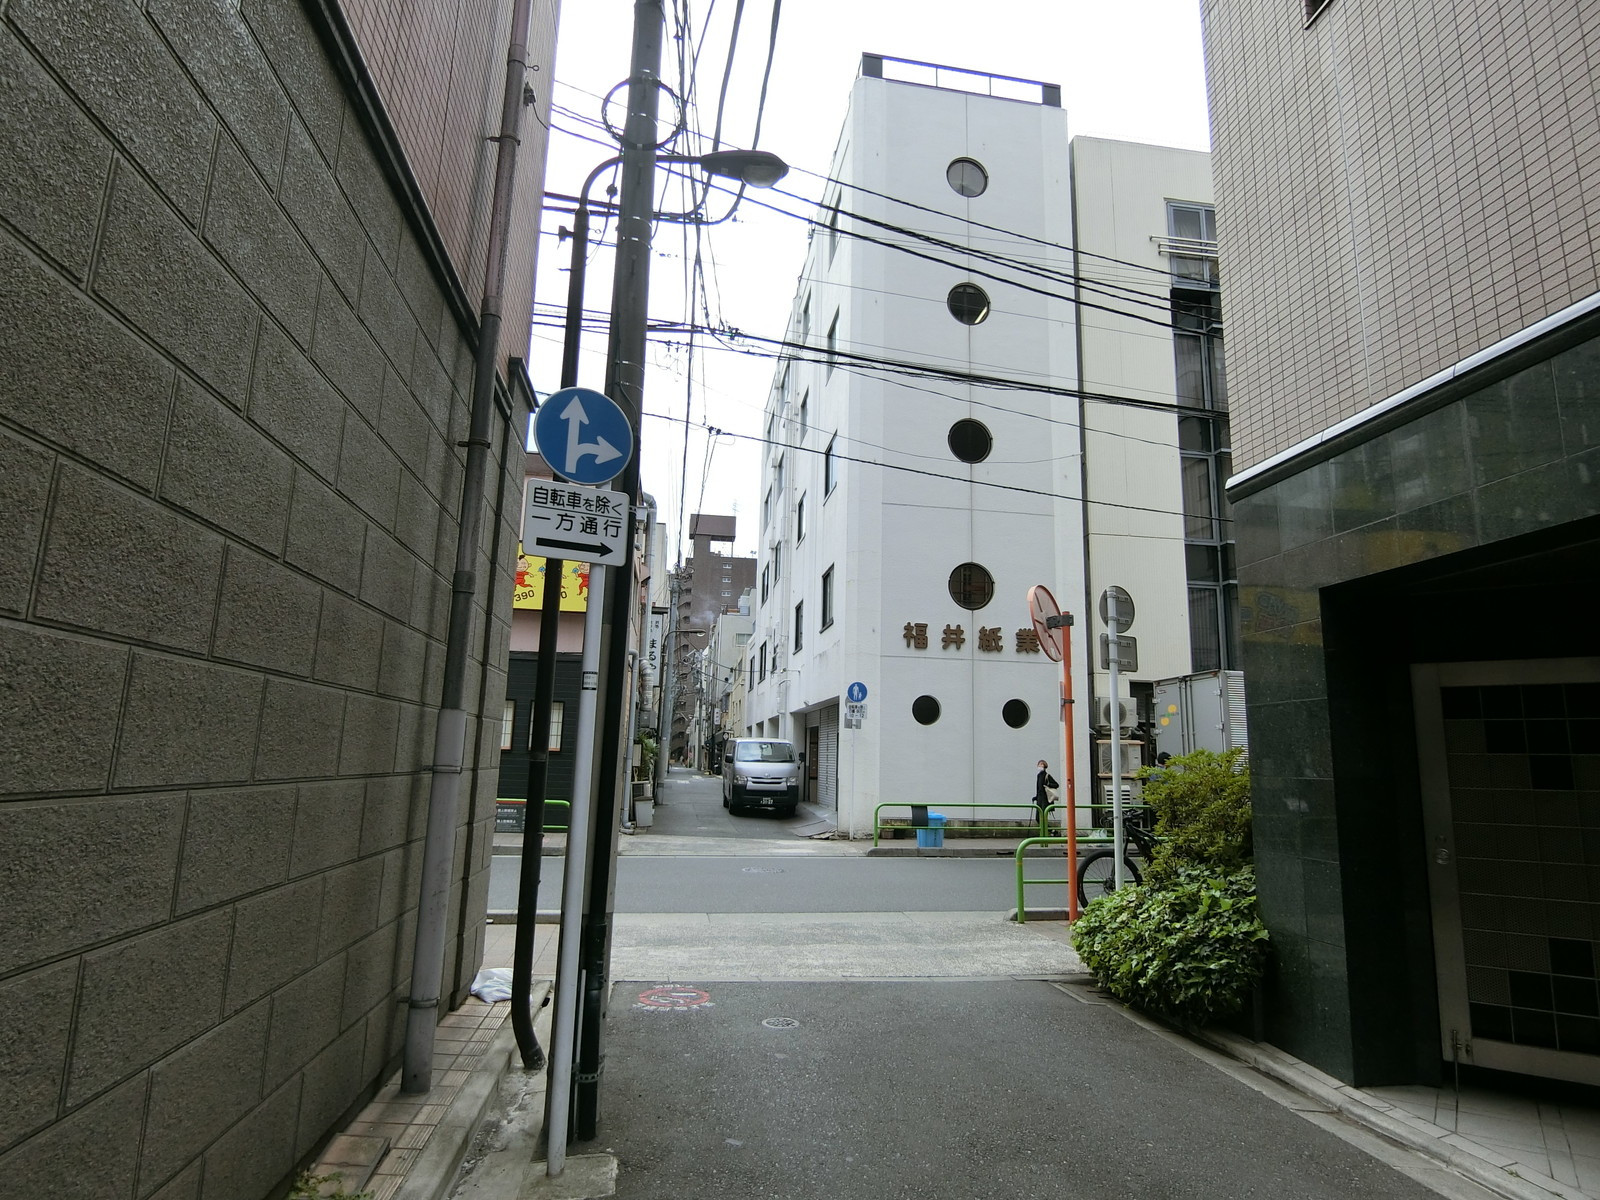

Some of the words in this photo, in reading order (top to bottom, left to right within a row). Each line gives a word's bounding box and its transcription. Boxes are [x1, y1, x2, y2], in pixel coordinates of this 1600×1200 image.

[532, 486, 623, 516] 自転車を除く
[531, 512, 622, 538] 一方通行
[903, 622, 1041, 653] 福井紙業
